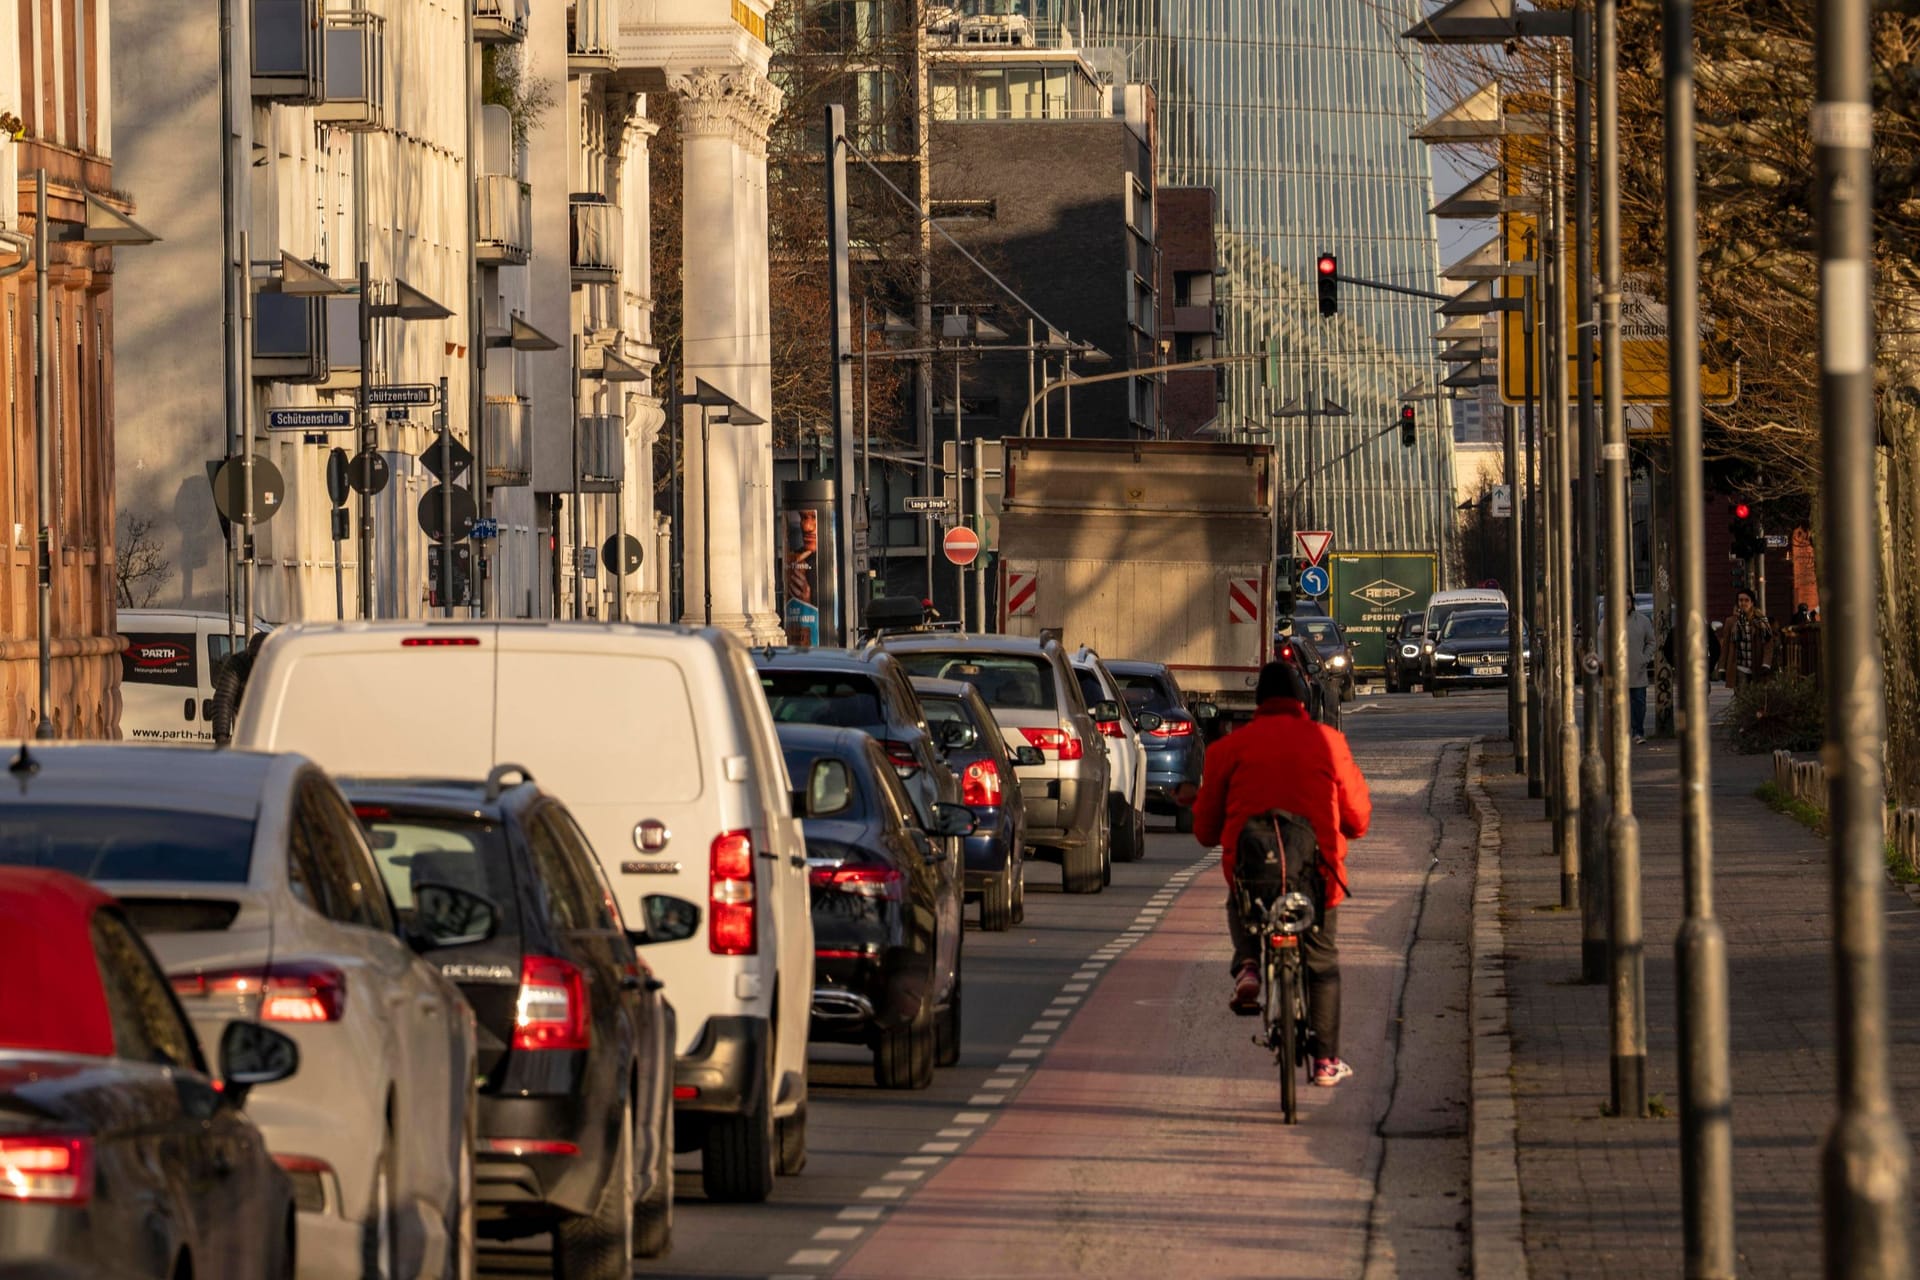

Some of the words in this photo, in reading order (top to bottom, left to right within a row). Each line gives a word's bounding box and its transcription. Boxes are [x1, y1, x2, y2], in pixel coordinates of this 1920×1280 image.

[368, 390, 428, 403] chützenstraße
[277, 412, 344, 425] Schützenstraße
[911, 501, 927, 509] Lange
[929, 500, 946, 508] Straße
[1361, 613, 1401, 621] SPEDITIO
[1345, 625, 1384, 633] ANKFURT/M.
[141, 648, 176, 658] PARTH
[442, 964, 513, 977] OCTAVIA
